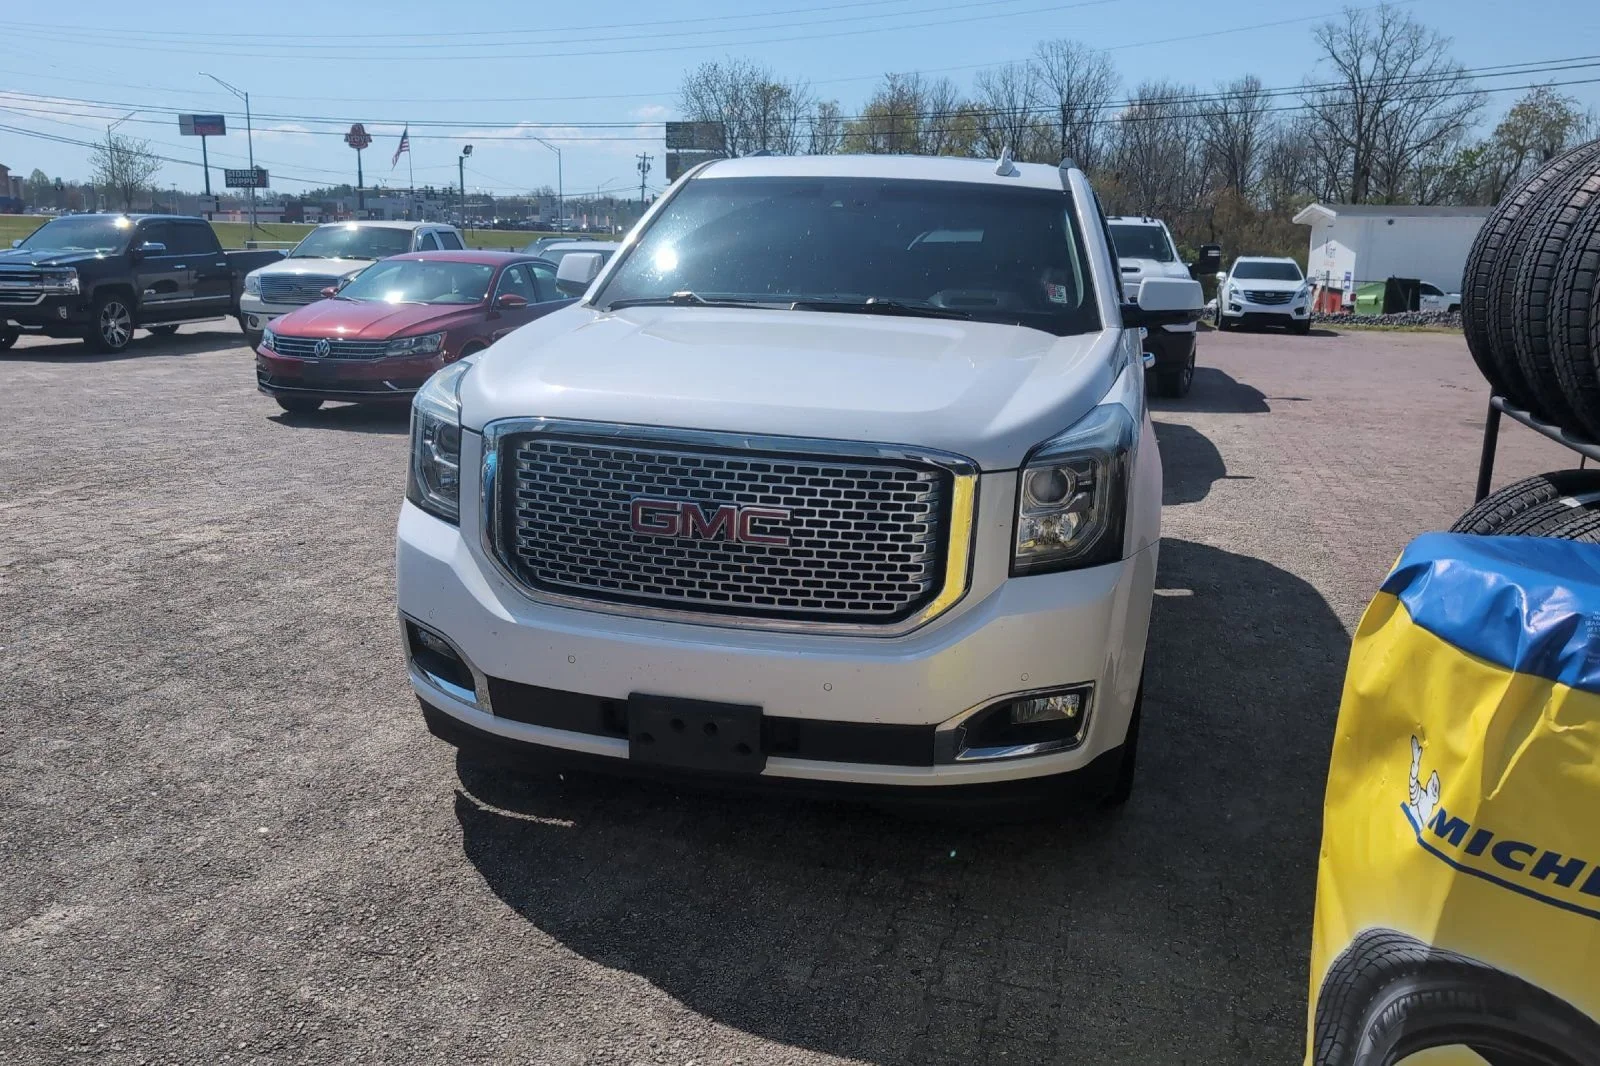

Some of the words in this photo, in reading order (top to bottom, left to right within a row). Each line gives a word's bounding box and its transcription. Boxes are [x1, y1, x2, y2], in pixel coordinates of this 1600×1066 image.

[226, 170, 258, 178] SIDING
[226, 177, 259, 185] SUPPLY
[630, 496, 793, 547] GMC
